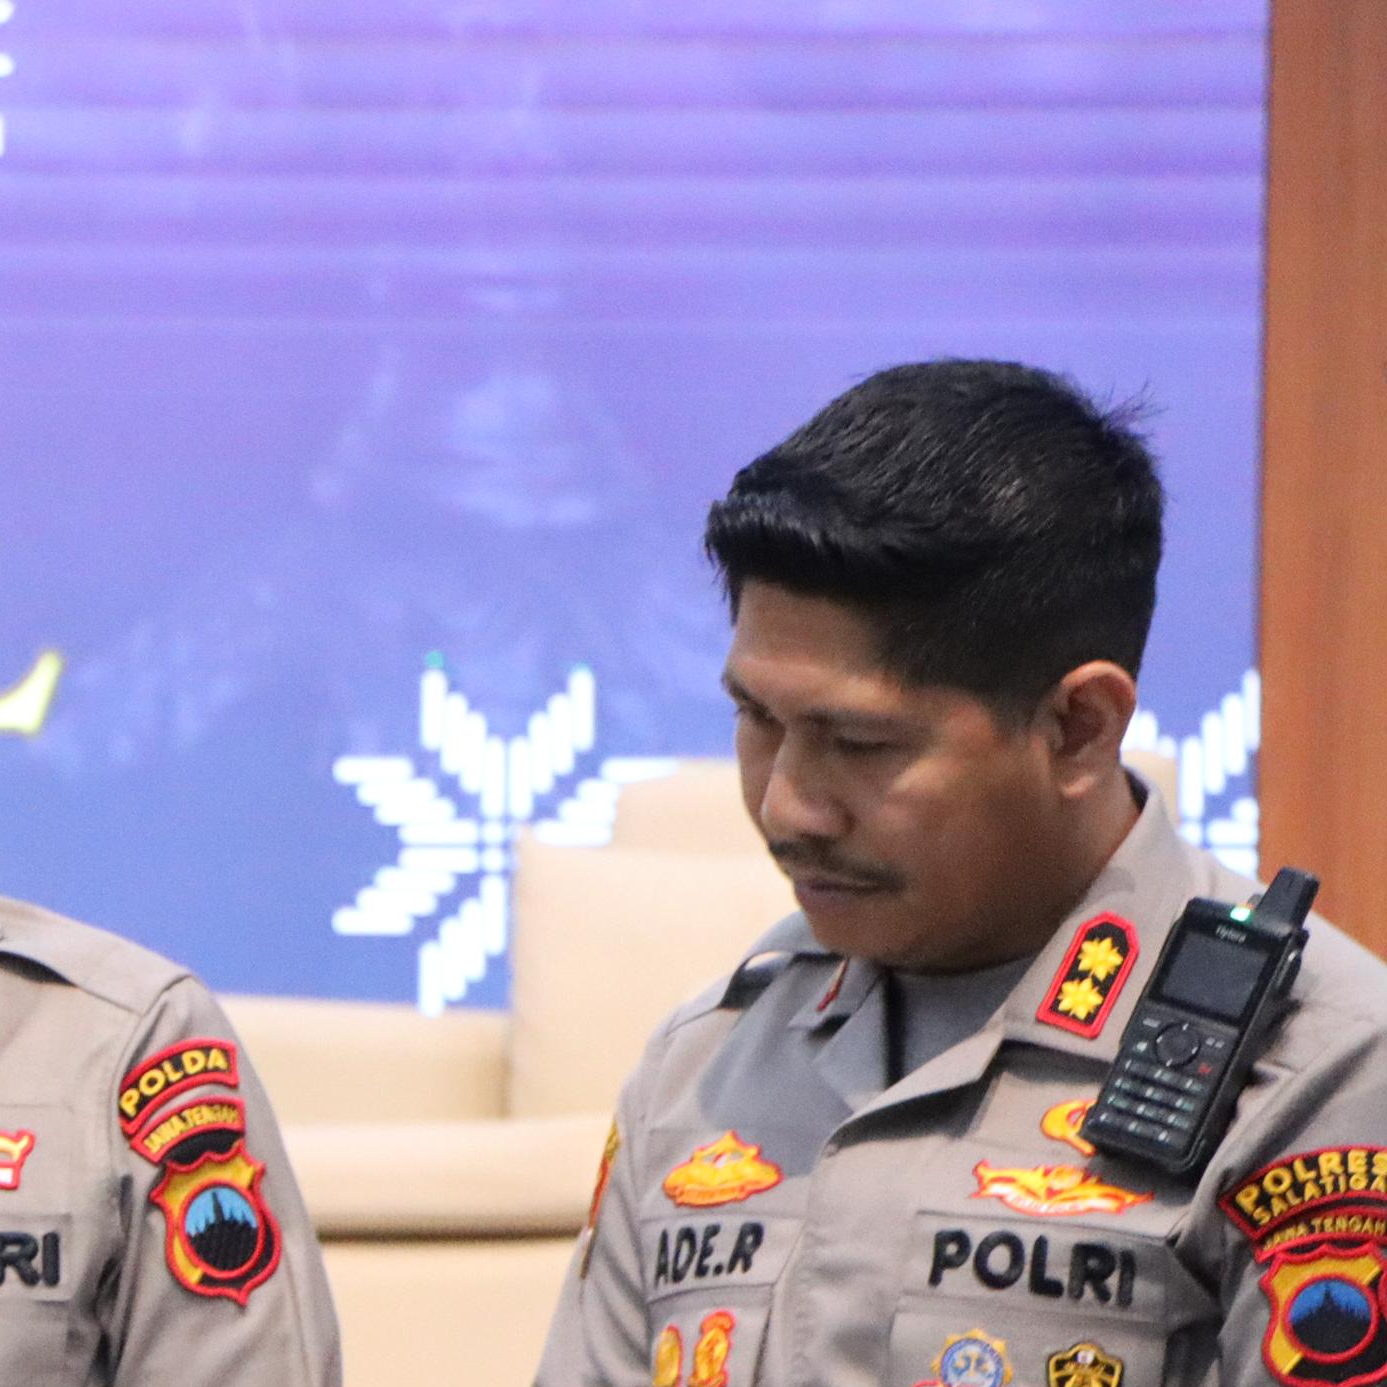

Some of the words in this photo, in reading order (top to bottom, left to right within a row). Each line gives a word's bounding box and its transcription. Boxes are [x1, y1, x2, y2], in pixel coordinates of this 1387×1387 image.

[119, 1047, 230, 1118] POLDA
[1235, 1149, 1387, 1216] POLRES
[653, 1222, 764, 1290] ADE.R
[927, 1229, 1137, 1306] POLRI
